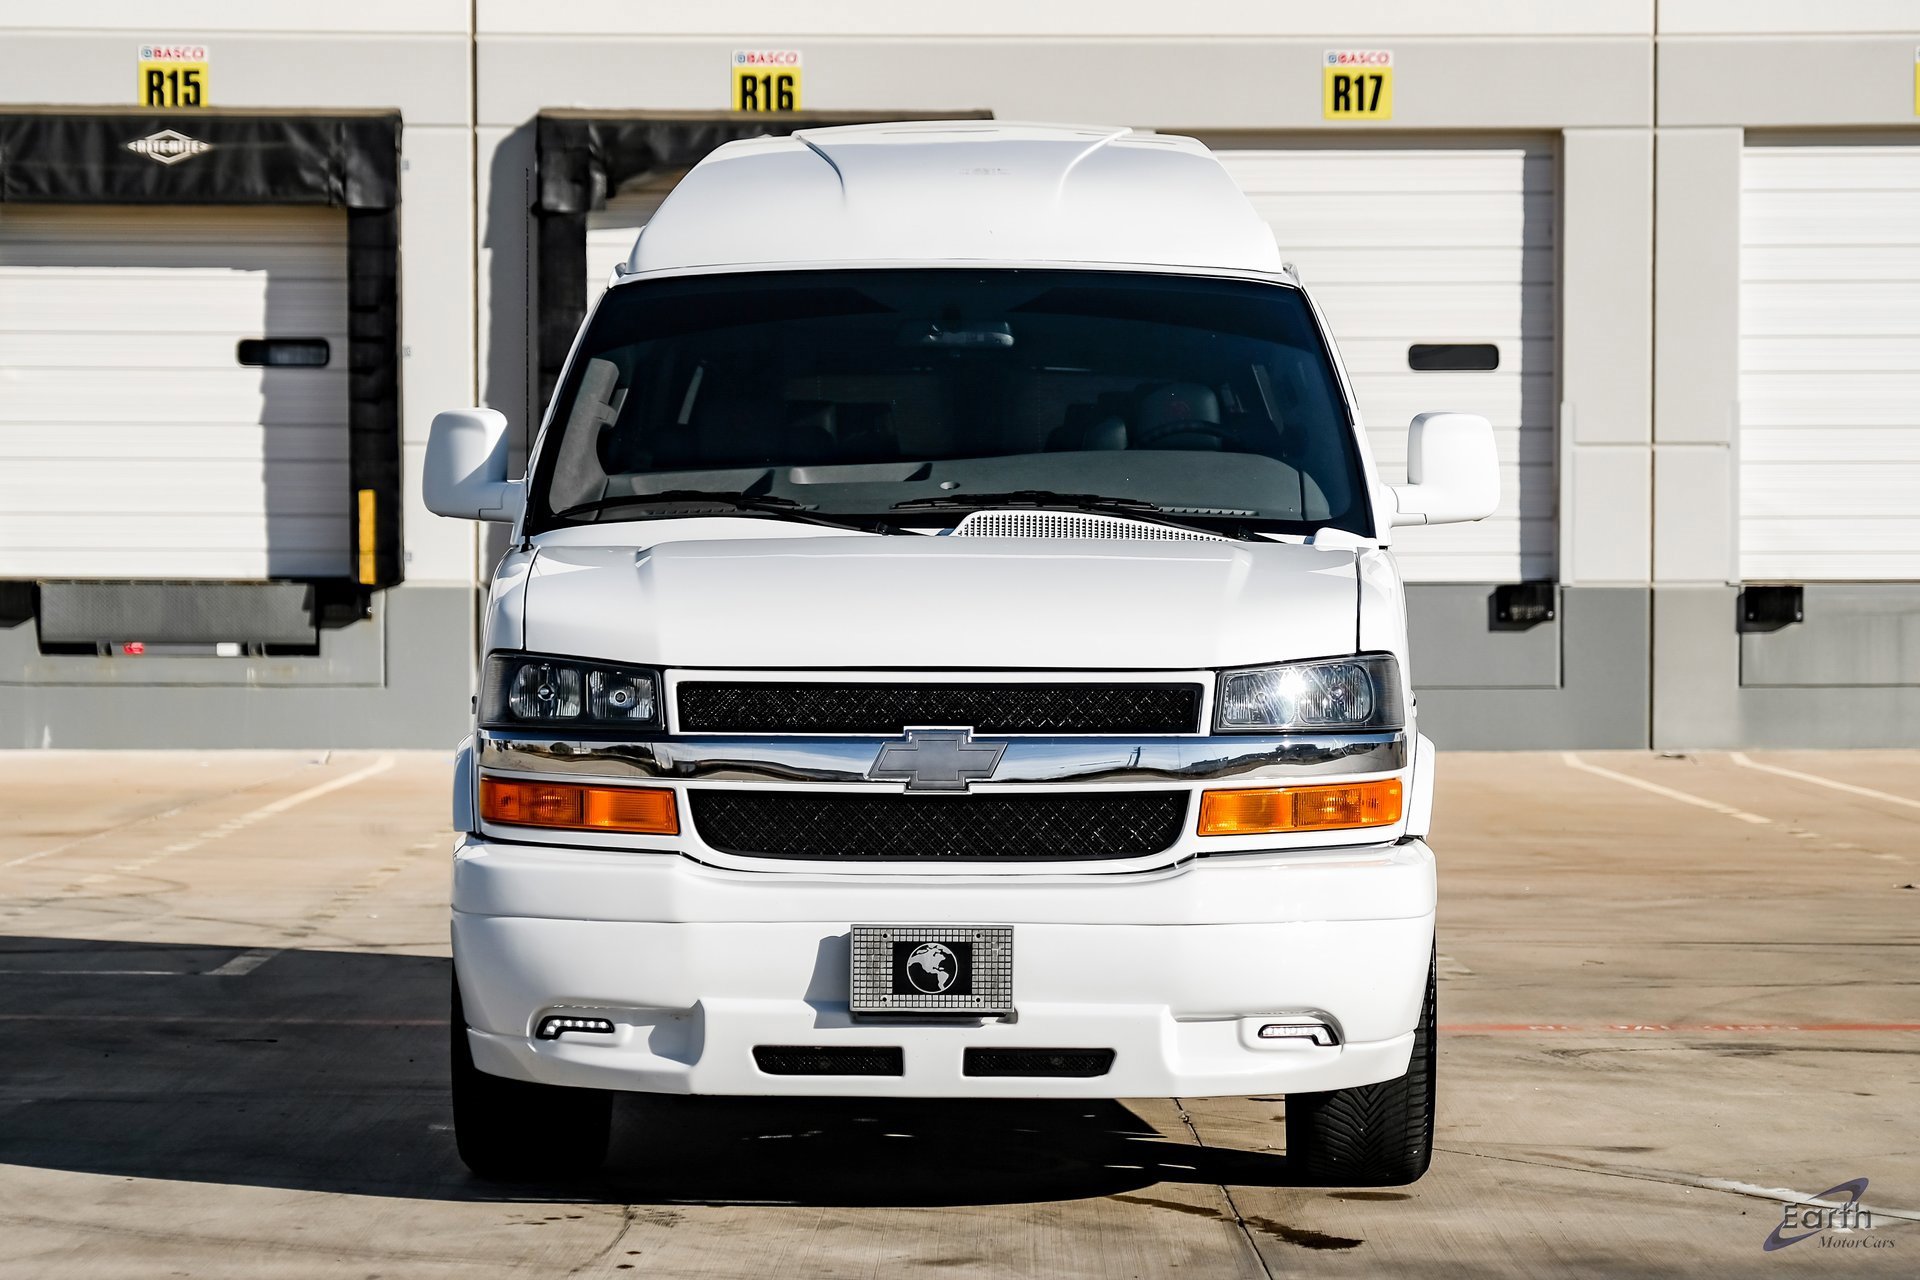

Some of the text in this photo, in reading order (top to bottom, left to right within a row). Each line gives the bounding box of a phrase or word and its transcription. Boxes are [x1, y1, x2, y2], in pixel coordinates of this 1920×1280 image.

[153, 48, 204, 59] BASCO
[746, 52, 797, 64] BASCO
[1338, 53, 1389, 64] BASCO
[147, 70, 201, 107] R15
[741, 75, 794, 112] R16
[1334, 75, 1383, 111] R17
